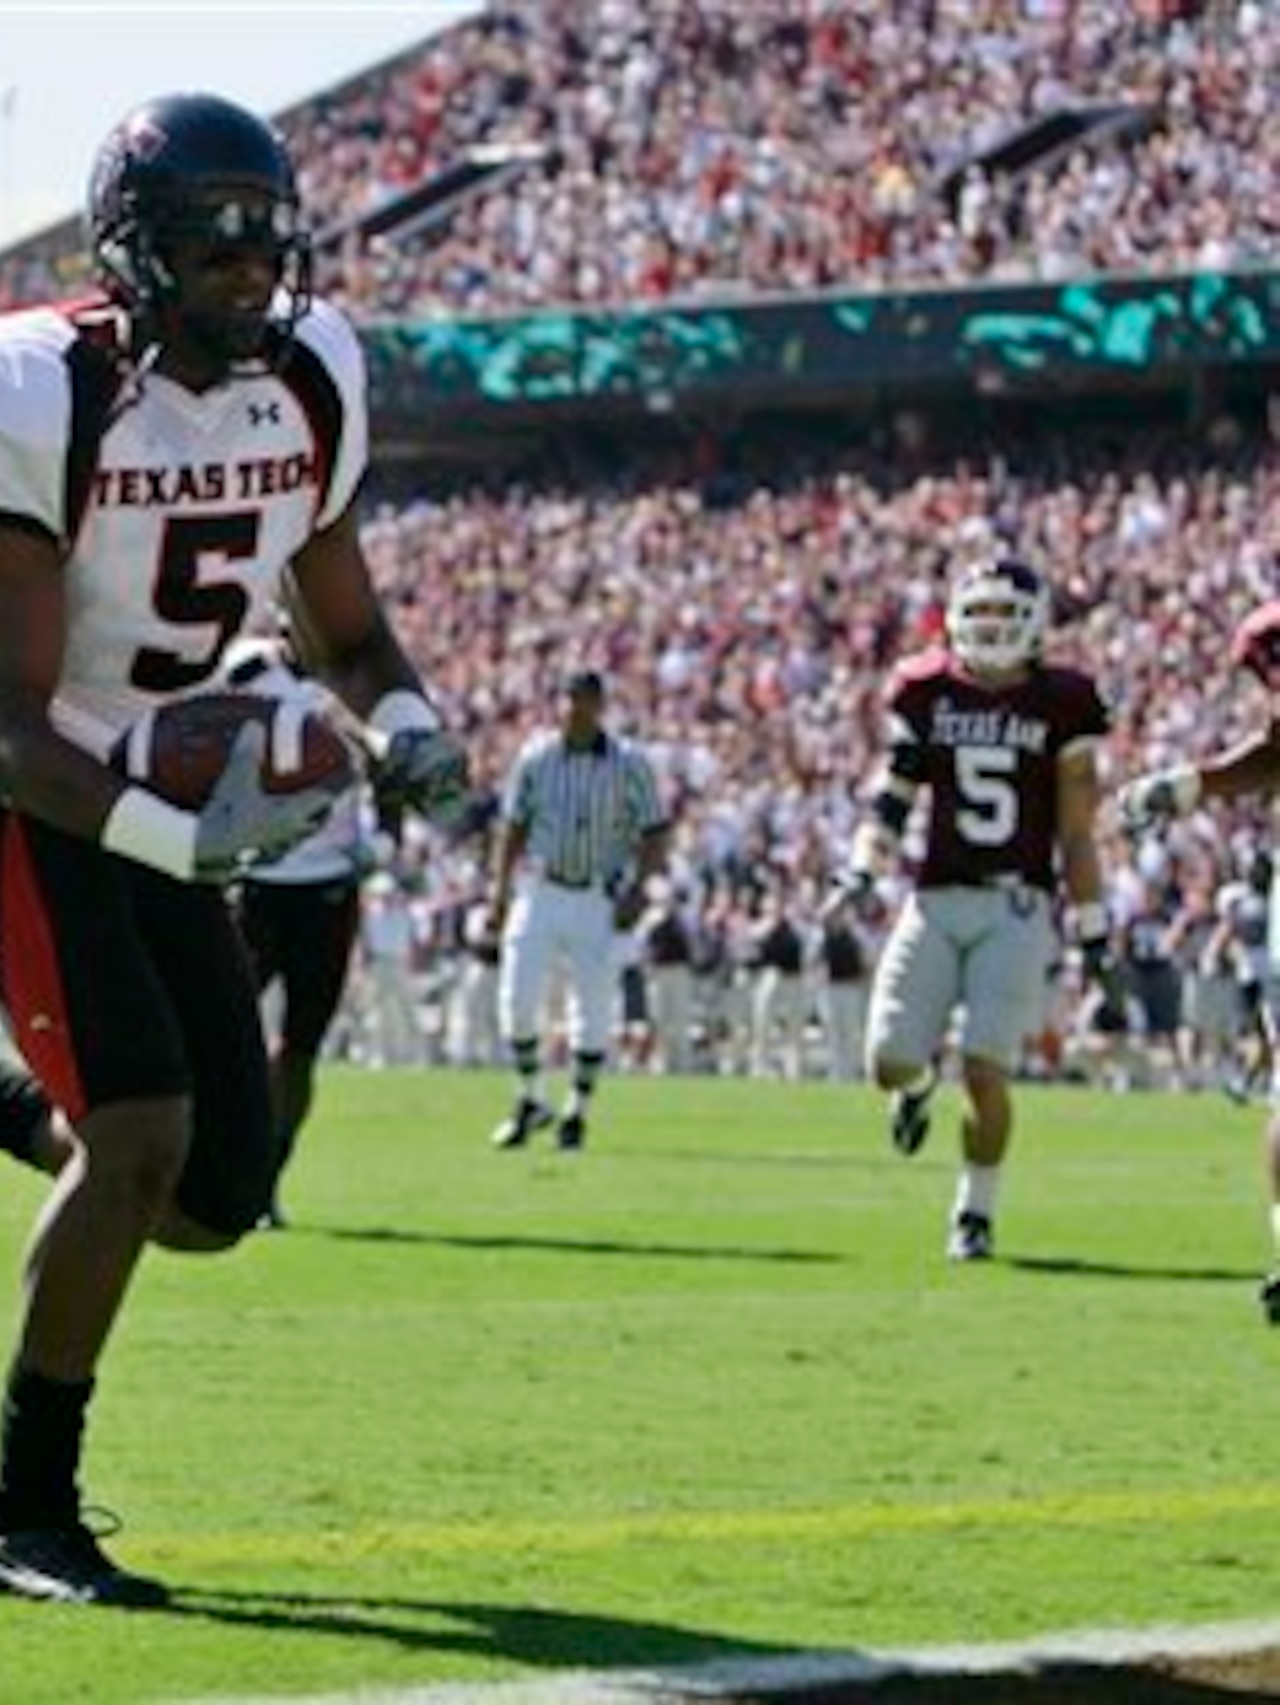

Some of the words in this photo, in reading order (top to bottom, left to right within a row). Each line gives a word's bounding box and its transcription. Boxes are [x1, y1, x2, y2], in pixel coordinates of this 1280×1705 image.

[97, 464, 225, 506] TEXAS
[128, 511, 263, 691] 5
[954, 746, 1016, 845] 5
